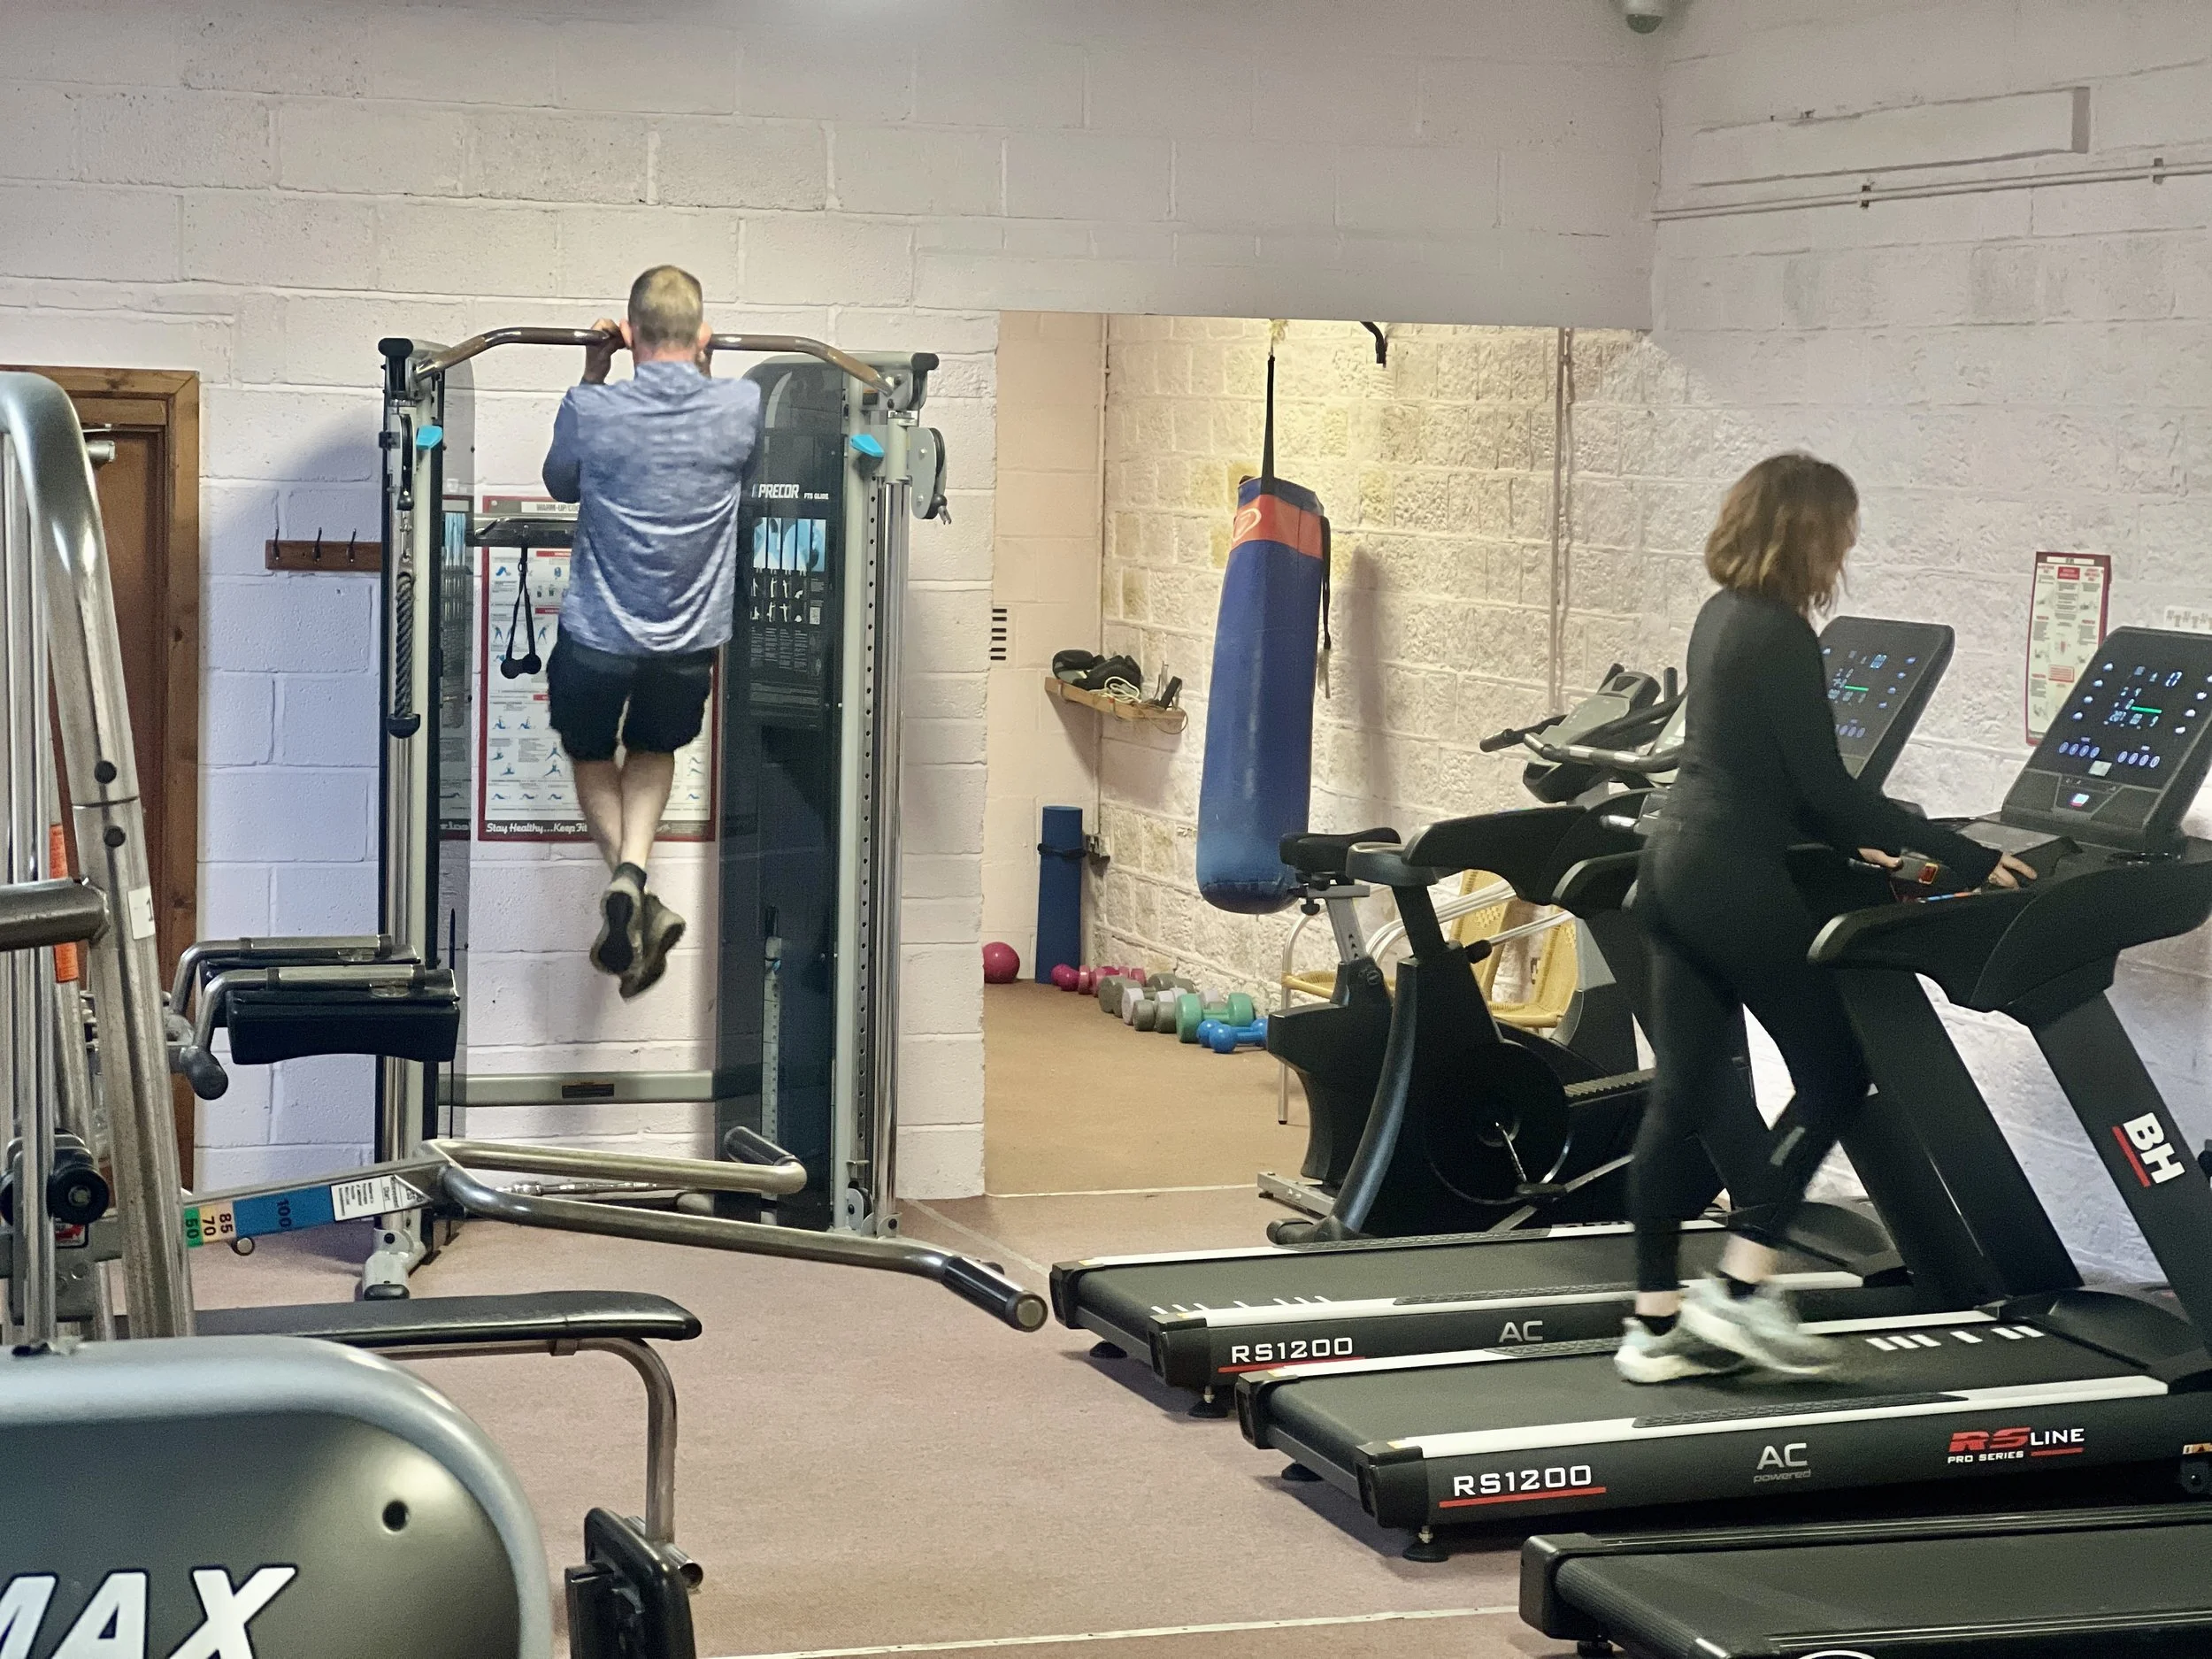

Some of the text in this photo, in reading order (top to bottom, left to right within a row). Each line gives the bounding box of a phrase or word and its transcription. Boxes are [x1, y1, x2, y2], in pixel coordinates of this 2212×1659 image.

[758, 484, 800, 499] PRECOR
[486, 823, 508, 834] Stay
[576, 823, 588, 833] Fit
[2123, 1111, 2185, 1184] BH
[219, 1212, 234, 1233] 85
[276, 1198, 292, 1228] 100
[185, 1217, 199, 1240] 50
[202, 1216, 216, 1237] 70
[1499, 1320, 1542, 1342] AC
[1230, 1337, 1353, 1363] RS1200
[1757, 1442, 1807, 1470] AC
[1947, 1451, 2024, 1463] PRO SERIES
[1453, 1465, 1593, 1496] RS1200
[1753, 1470, 1811, 1484] powered
